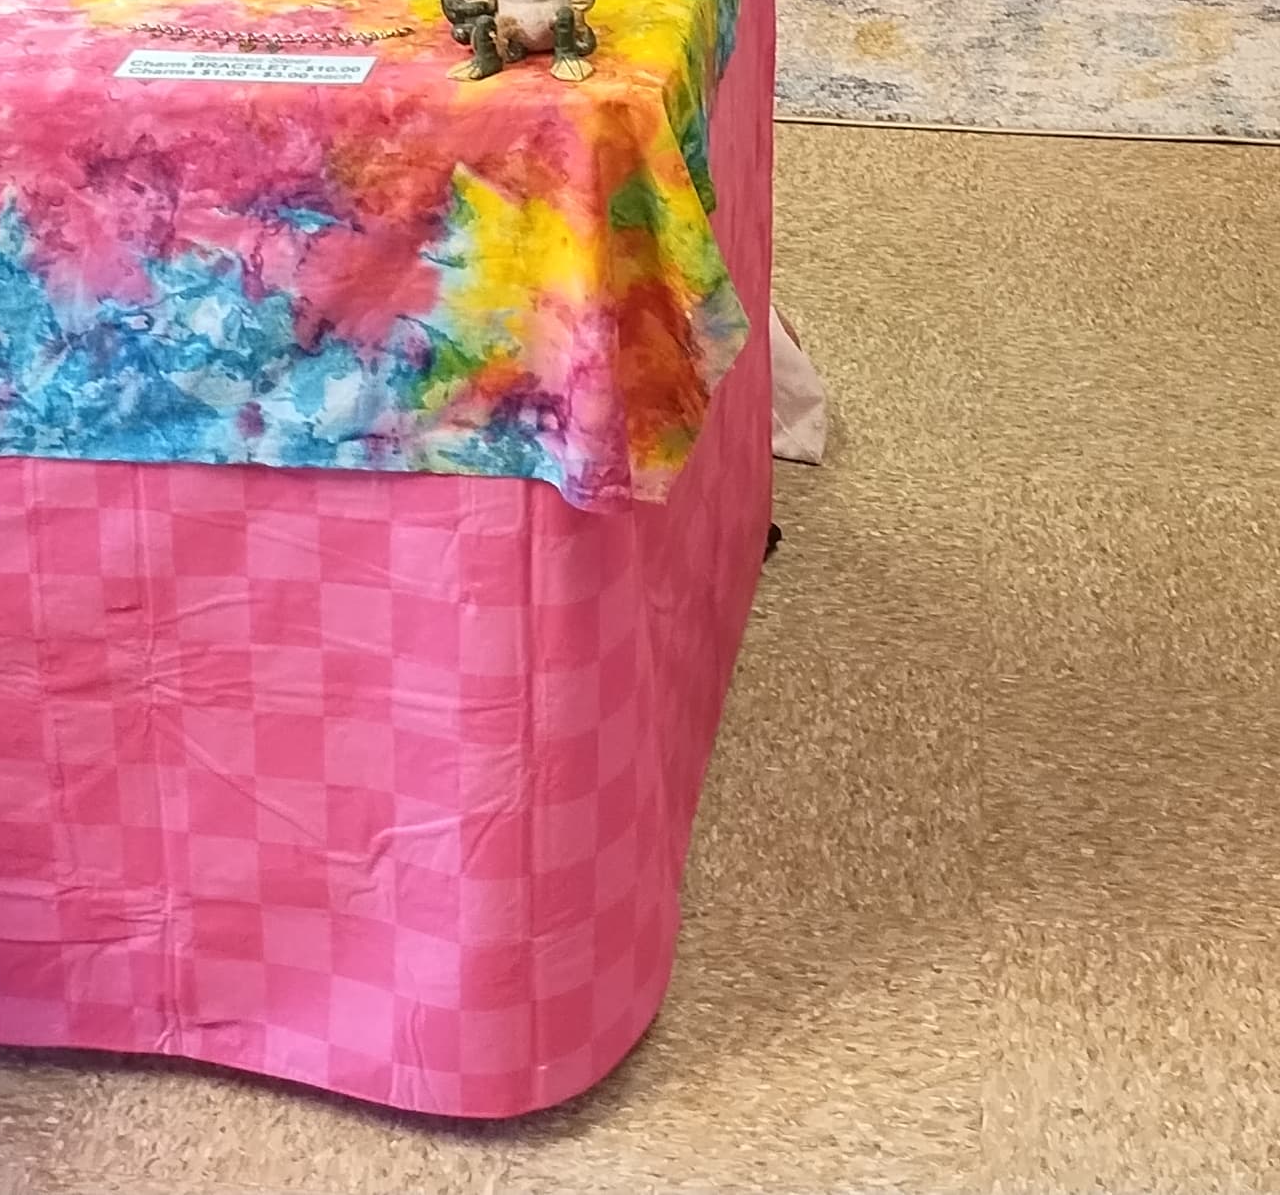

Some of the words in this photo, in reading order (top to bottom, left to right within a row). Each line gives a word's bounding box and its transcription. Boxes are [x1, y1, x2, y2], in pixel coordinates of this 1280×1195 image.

[130, 59, 187, 68] Charm
[192, 61, 289, 71] BRACELET
[128, 67, 196, 77] Charms
